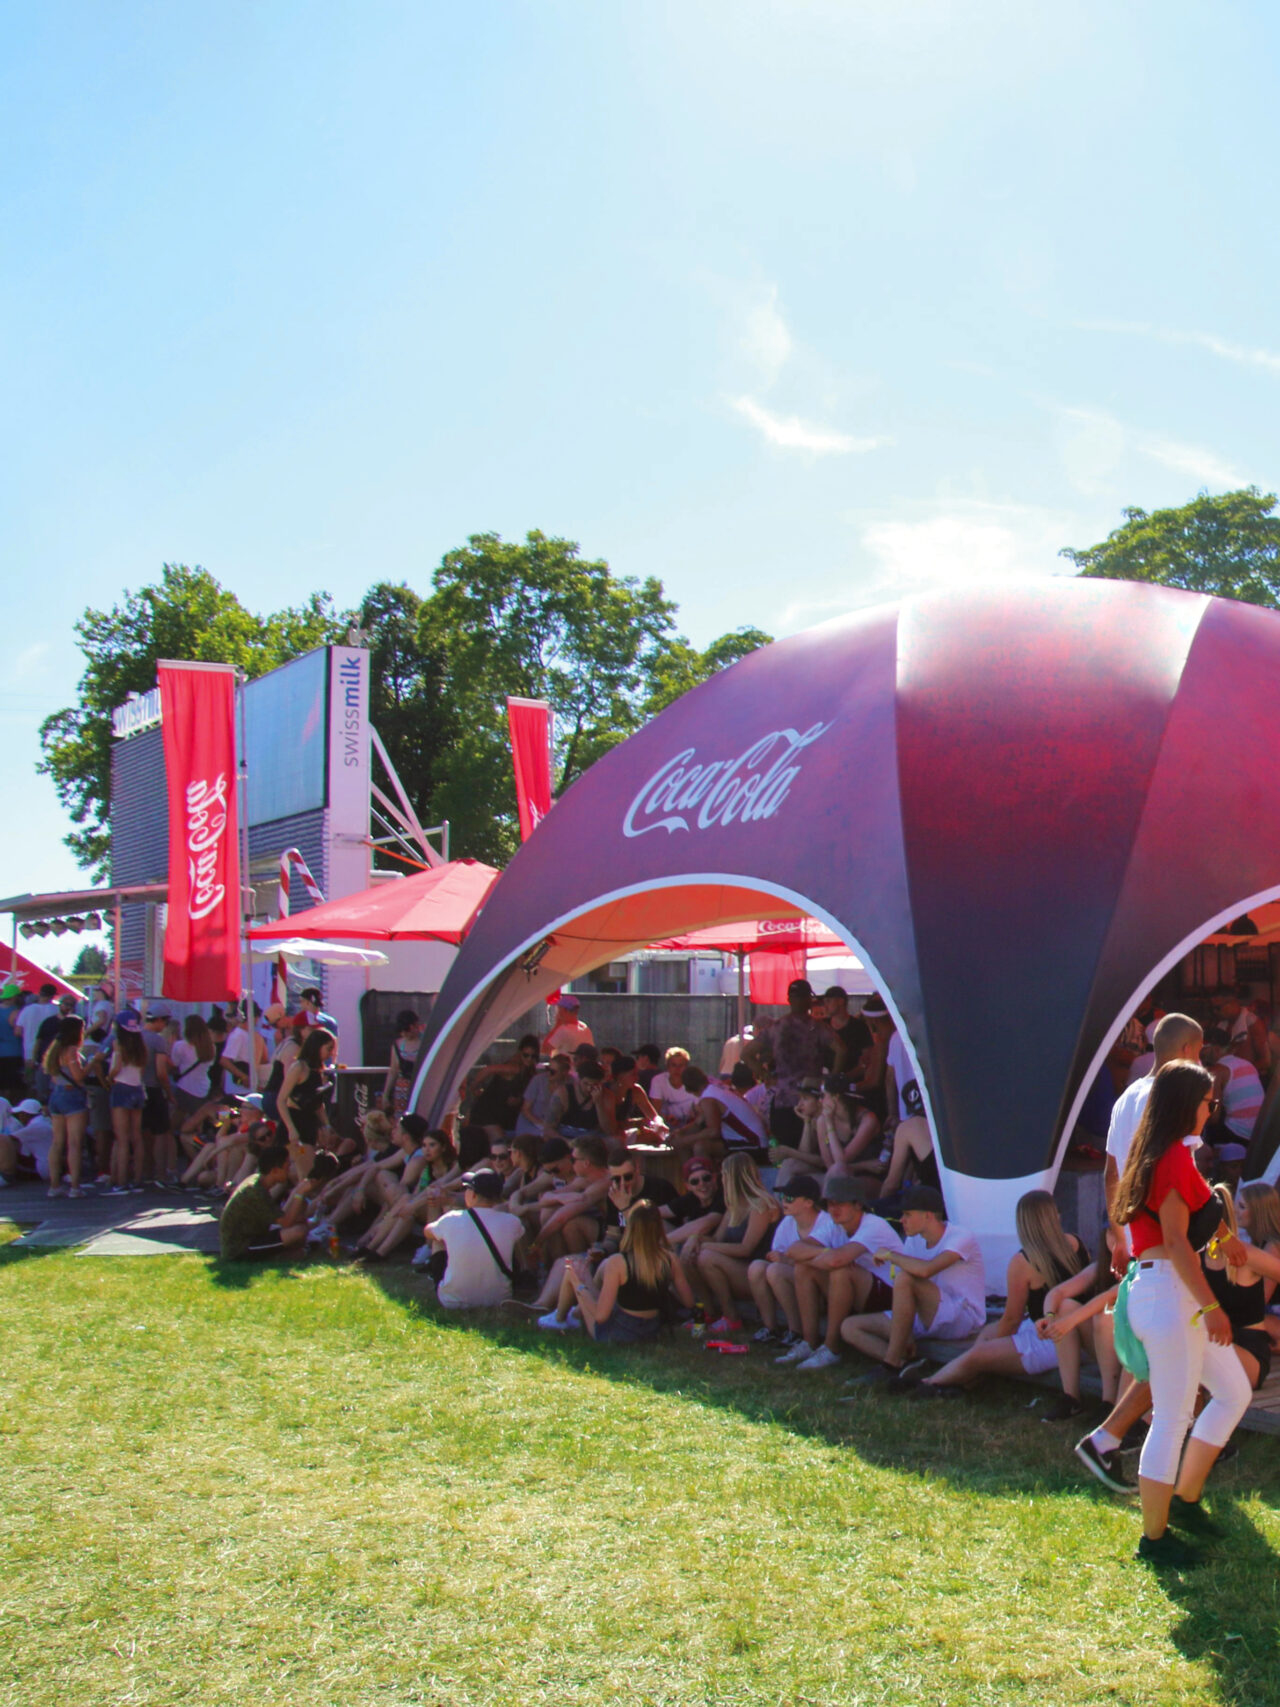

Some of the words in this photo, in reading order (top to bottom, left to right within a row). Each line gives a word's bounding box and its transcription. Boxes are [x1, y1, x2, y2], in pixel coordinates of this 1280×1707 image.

[340, 656, 361, 768] swissmilk
[622, 717, 840, 838] Coca-Cola
[186, 772, 227, 920] Coca-Cola
